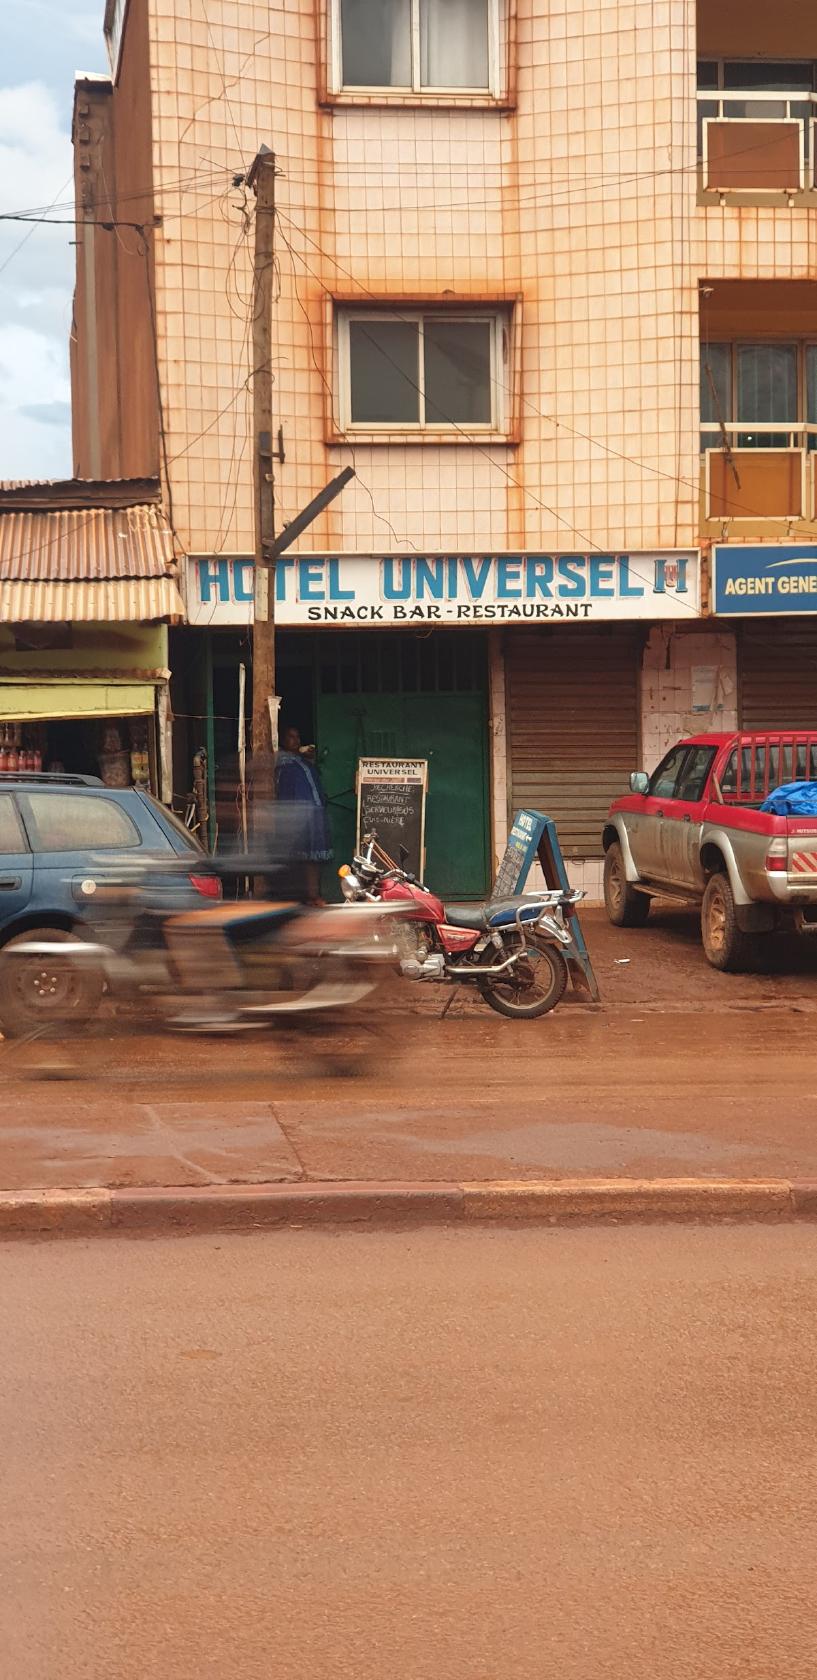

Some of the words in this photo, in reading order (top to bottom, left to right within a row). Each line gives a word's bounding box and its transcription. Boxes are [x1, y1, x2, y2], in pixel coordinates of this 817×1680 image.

[198, 558, 355, 602] HOTEL
[383, 556, 645, 600] UNIVERSEL
[725, 576, 775, 595] AGENT
[777, 575, 817, 594] GENE
[307, 606, 383, 620] SNACK
